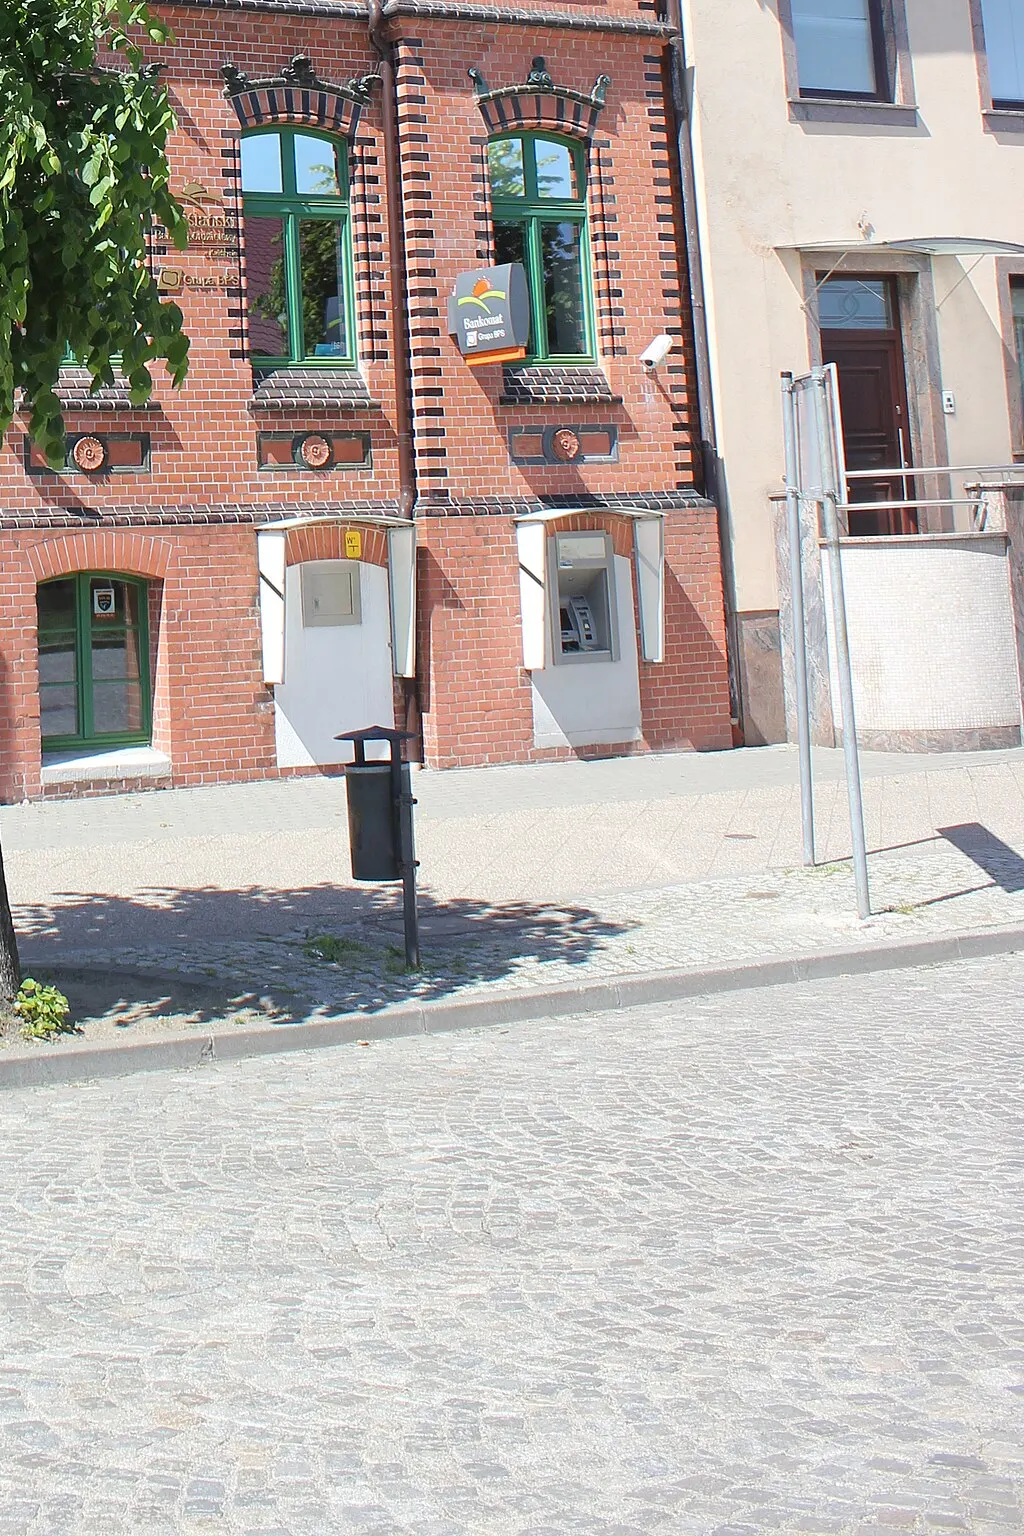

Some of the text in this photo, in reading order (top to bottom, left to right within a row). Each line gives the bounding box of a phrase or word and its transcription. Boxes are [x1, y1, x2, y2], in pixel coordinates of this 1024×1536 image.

[183, 275, 240, 287] Grupa BPS
[463, 313, 504, 329] Bankomat
[493, 329, 506, 338] BPS
